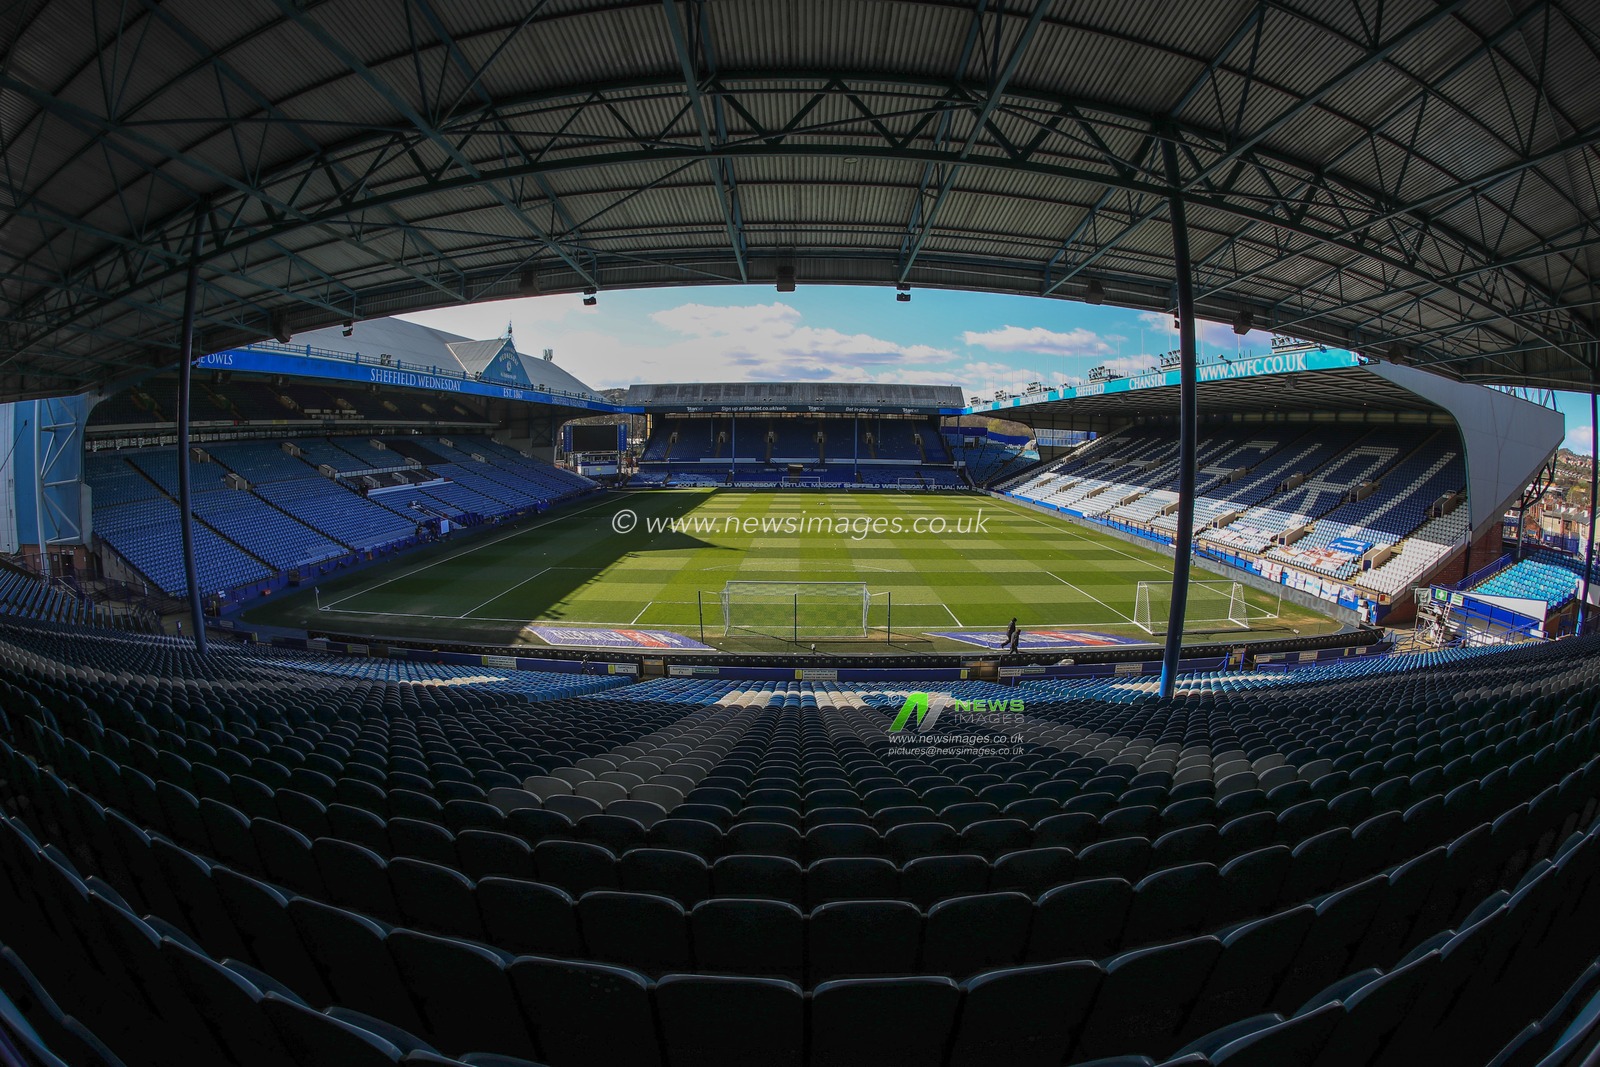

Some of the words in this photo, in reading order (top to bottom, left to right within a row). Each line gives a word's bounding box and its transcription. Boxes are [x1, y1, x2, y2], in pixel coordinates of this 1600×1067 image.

[207, 353, 233, 365] OWLS
[1198, 353, 1307, 381] WWW.SWFC.CO.UK
[370, 368, 416, 386] SHEFFIELD
[417, 375, 462, 391] WEDNESDAY
[1128, 373, 1167, 390] CHANSIRI
[1075, 383, 1105, 397] SHEFFIELD
